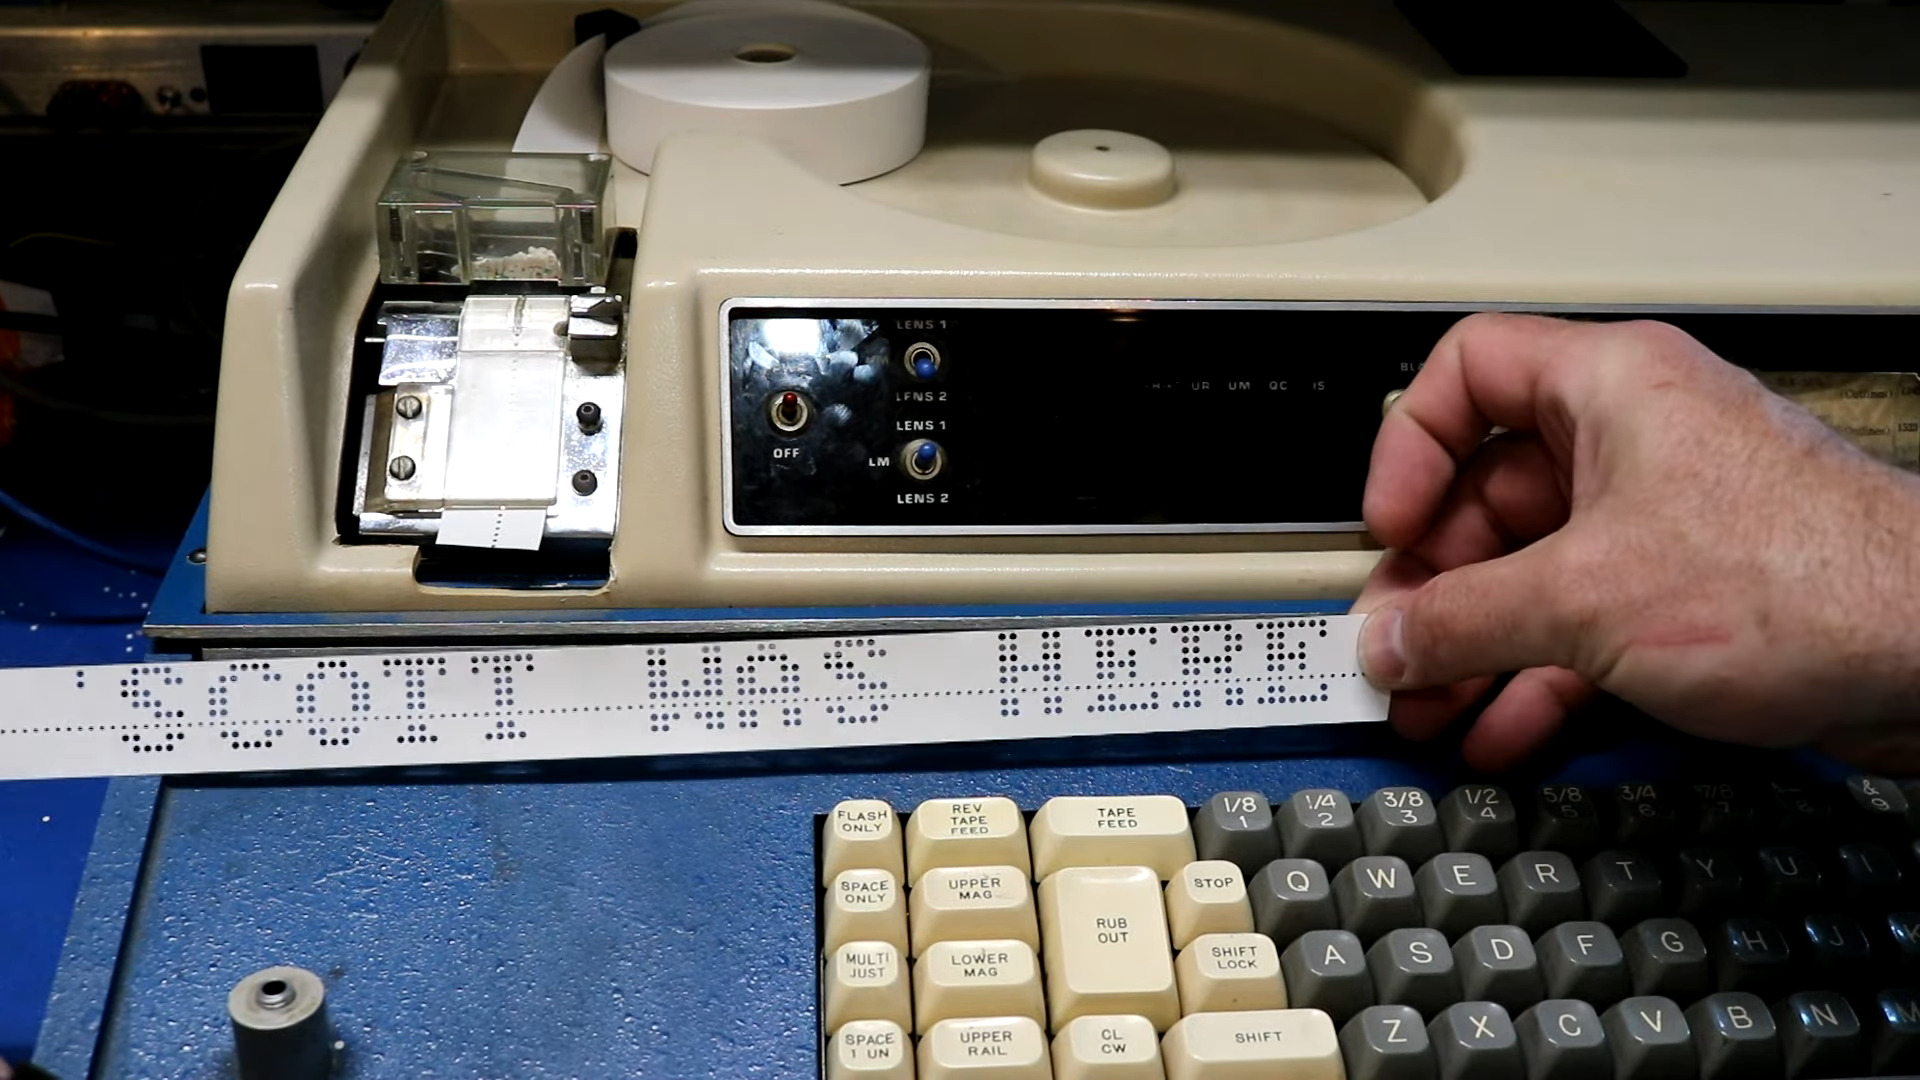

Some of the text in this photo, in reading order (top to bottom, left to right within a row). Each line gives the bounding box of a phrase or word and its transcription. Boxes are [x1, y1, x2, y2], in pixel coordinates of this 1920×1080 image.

[897, 320, 946, 329] LENS 1
[1191, 381, 1210, 391] UR
[1228, 381, 1251, 391] UM
[1269, 381, 1288, 391] QC
[896, 391, 947, 401] LENS 2
[896, 421, 946, 431] LENS 1
[773, 448, 799, 458] OFF
[868, 457, 890, 467] LM
[897, 494, 949, 504] LENS 2
[646, 636, 887, 731] WAS
[998, 620, 1328, 722] HERE
[1543, 787, 1582, 802] 5/8
[1862, 780, 1879, 796] &
[1305, 794, 1336, 810] 1/4
[1383, 791, 1423, 807] 3/8
[1465, 789, 1500, 805] 1/2
[953, 803, 981, 815] REV
[1223, 795, 1257, 813] 1/8
[837, 809, 888, 822] FLASH
[1098, 807, 1136, 818] TAPE
[1401, 809, 1418, 824] 3
[1480, 807, 1497, 820] 4
[950, 815, 987, 825] TAPE
[1098, 818, 1138, 829] FEED
[1240, 815, 1247, 828] 1
[1317, 813, 1334, 826] 2
[842, 822, 883, 834] ONLY
[950, 826, 989, 835] FEED
[1615, 861, 1635, 881] T
[1696, 858, 1715, 879] Y
[1773, 855, 1799, 876] U
[1365, 867, 1397, 888] W
[1453, 866, 1476, 885] E
[1535, 864, 1559, 883] R
[841, 880, 889, 893] SPACE
[949, 876, 1001, 889] UPPER
[1194, 877, 1234, 889] STOP
[1287, 871, 1310, 892] Q
[845, 892, 887, 904] ONLY
[959, 888, 993, 900] MAG
[1097, 918, 1127, 930] RUB
[1099, 931, 1129, 943] OUT
[1660, 931, 1686, 953] G
[1741, 930, 1768, 951] H
[1829, 925, 1844, 946] J
[1212, 945, 1257, 957] SHIFT
[1490, 938, 1514, 960] D
[1576, 934, 1595, 955] F
[845, 952, 890, 964] MULTI
[951, 951, 1008, 965] LOWER
[1323, 944, 1347, 964] A
[1410, 942, 1433, 963] S
[1217, 957, 1258, 969] LOCK
[849, 966, 885, 978] JUST
[964, 964, 999, 977] MAG
[1639, 1010, 1663, 1032] V
[1725, 1006, 1753, 1029] B
[1809, 1003, 1839, 1026] N
[1381, 1020, 1408, 1043] Z
[1467, 1016, 1496, 1038] X
[1559, 1014, 1582, 1036] C
[845, 1032, 895, 1045] SPACE
[960, 1031, 1013, 1044] UPPER
[1101, 1029, 1123, 1041] CL
[1235, 1031, 1282, 1043] SHIFT
[850, 1046, 890, 1058] 1 UN
[968, 1043, 1007, 1055] RAIL
[1101, 1042, 1127, 1054] CW
